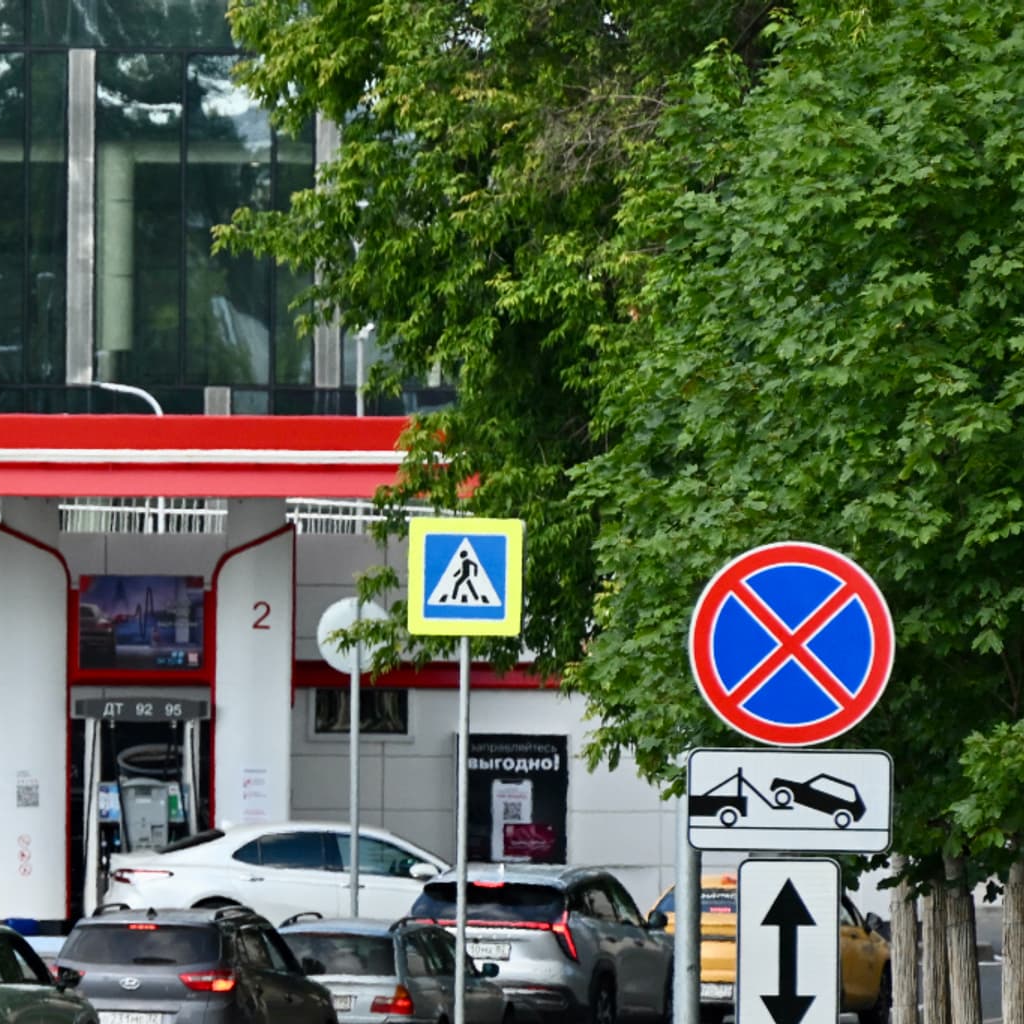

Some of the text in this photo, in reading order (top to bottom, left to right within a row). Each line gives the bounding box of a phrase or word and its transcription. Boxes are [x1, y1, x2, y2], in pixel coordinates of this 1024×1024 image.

[252, 601, 271, 630] 2
[103, 702, 182, 717] ДТ 92 95
[467, 753, 560, 773] выгодно!
